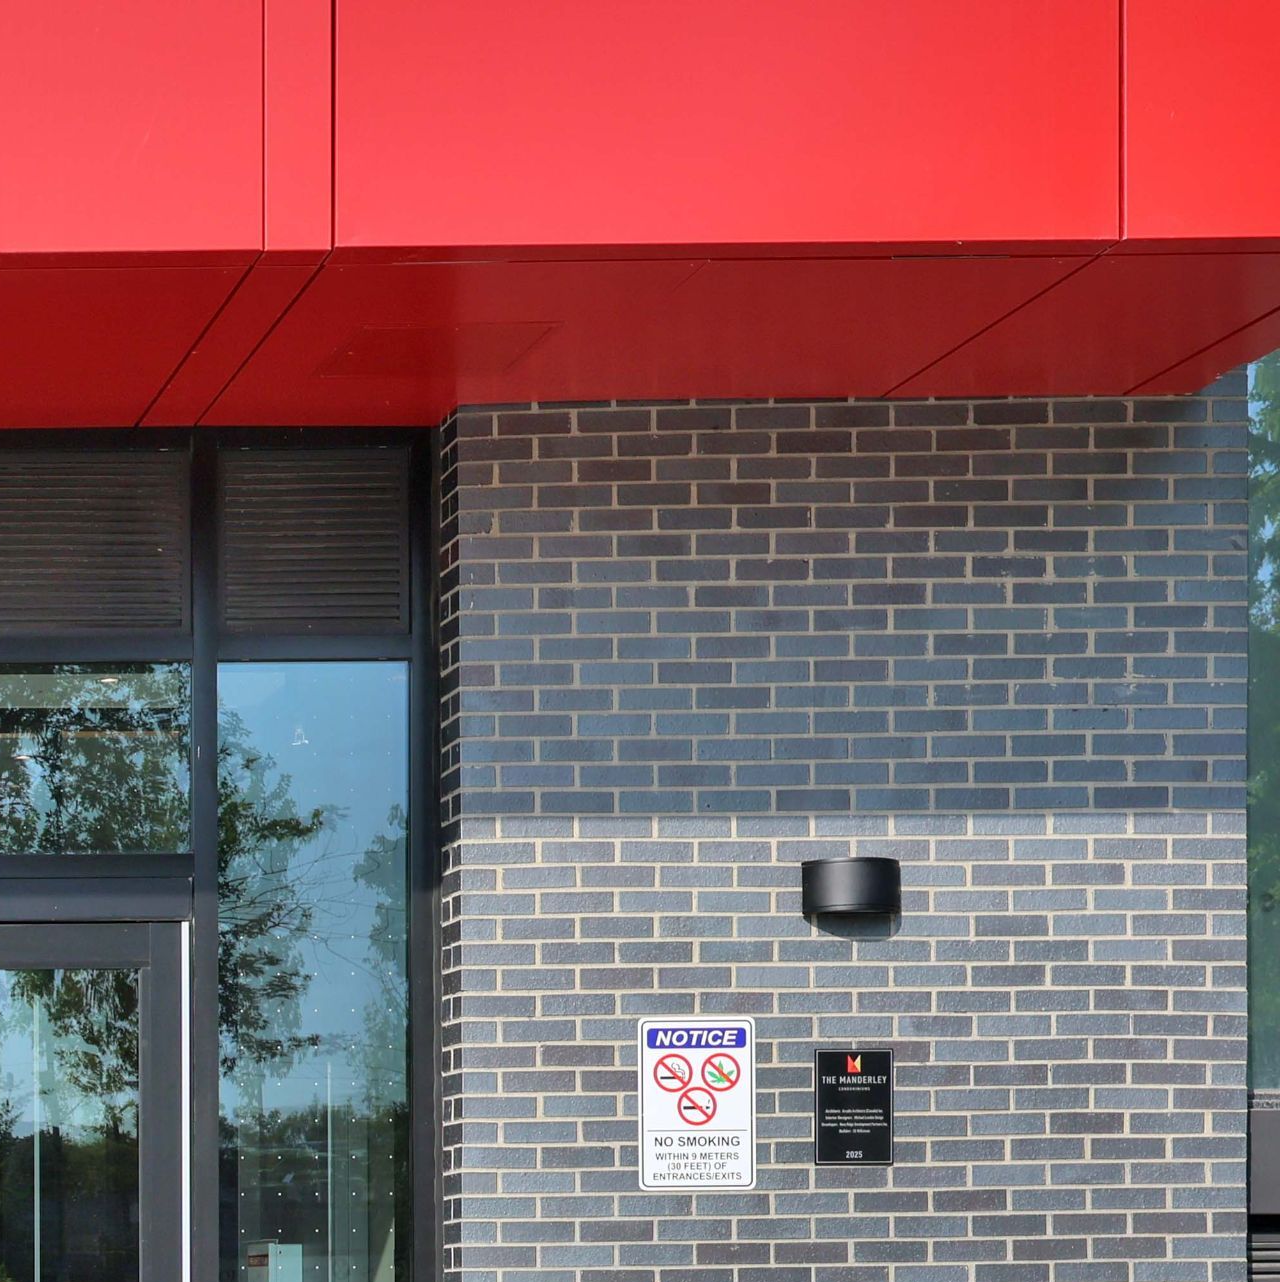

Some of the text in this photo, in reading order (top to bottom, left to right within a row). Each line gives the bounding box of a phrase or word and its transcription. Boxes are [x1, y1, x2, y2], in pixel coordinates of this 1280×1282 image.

[655, 1029, 738, 1046] NOTICE
[822, 1075, 888, 1085] THE MANDERLEY
[654, 1136, 741, 1147] NO SMOKING
[655, 1152, 740, 1161] WITHIN 9 METERS
[845, 1150, 863, 1159] 2025
[667, 1162, 728, 1172] (30 FEET) OF
[653, 1172, 742, 1181] ENTRANCES/EXITS
